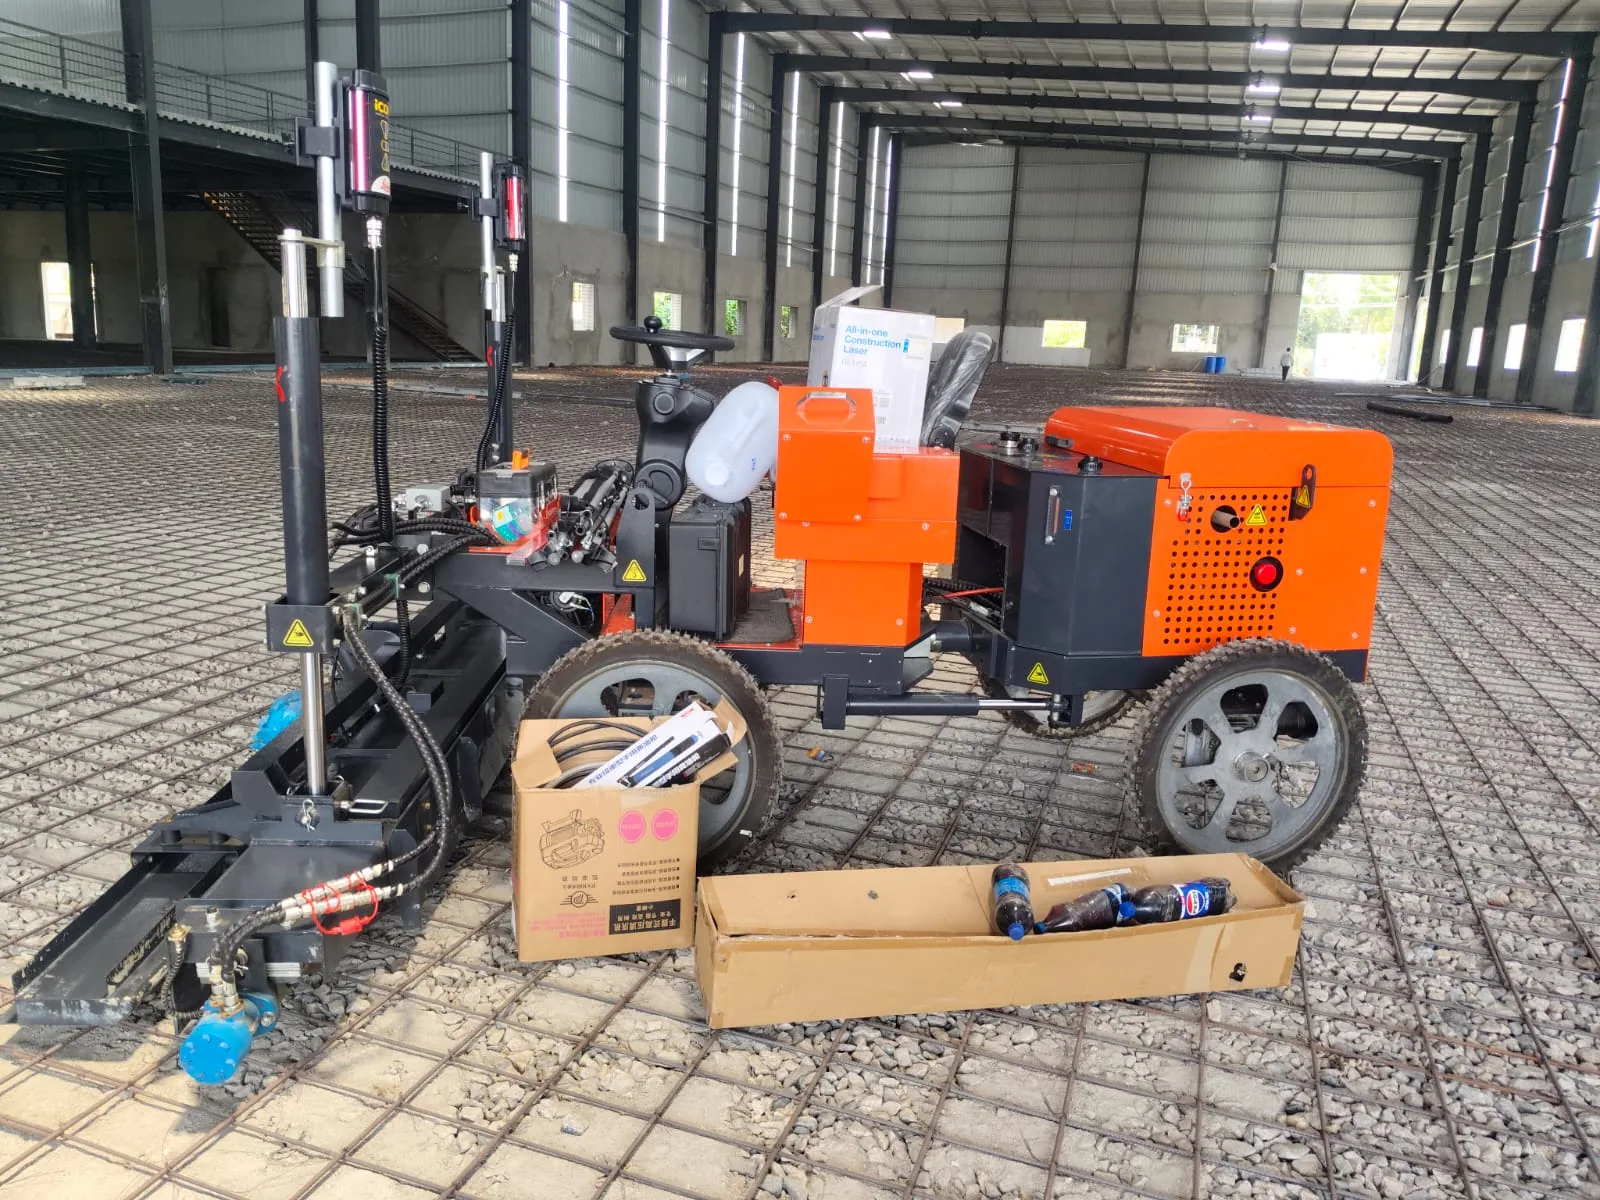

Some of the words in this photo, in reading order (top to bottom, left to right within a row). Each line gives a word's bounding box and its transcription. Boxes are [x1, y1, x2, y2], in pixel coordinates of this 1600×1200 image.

[845, 325, 888, 337] All-in-one
[844, 335, 902, 349] Construction
[843, 345, 868, 356] Laser
